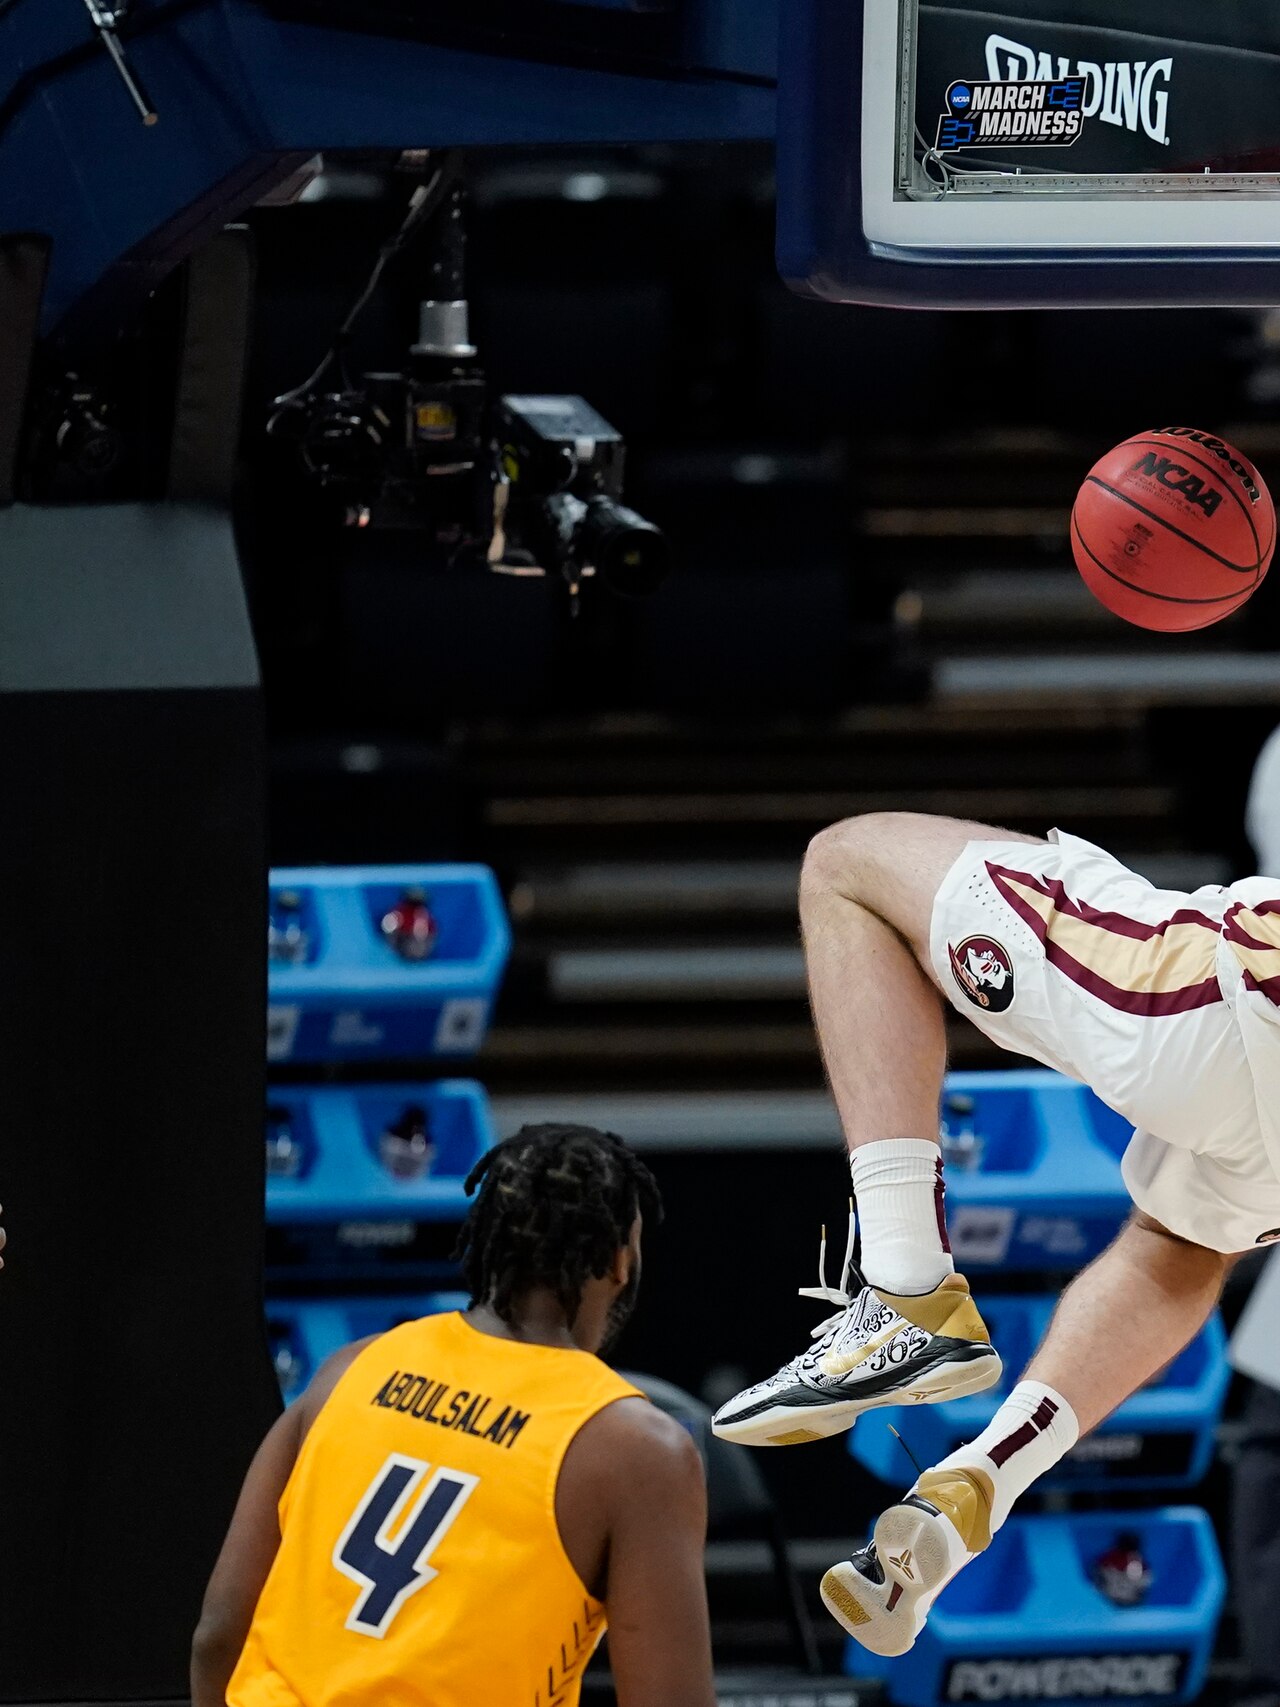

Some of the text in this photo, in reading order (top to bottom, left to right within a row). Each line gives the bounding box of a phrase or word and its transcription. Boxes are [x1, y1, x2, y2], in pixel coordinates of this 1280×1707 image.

[971, 86, 1046, 110] MARCH
[980, 111, 1079, 135] MADNESS
[1131, 451, 1223, 517] NCAA
[370, 1370, 532, 1449] ABDULSALAM
[331, 1452, 481, 1640] 4
